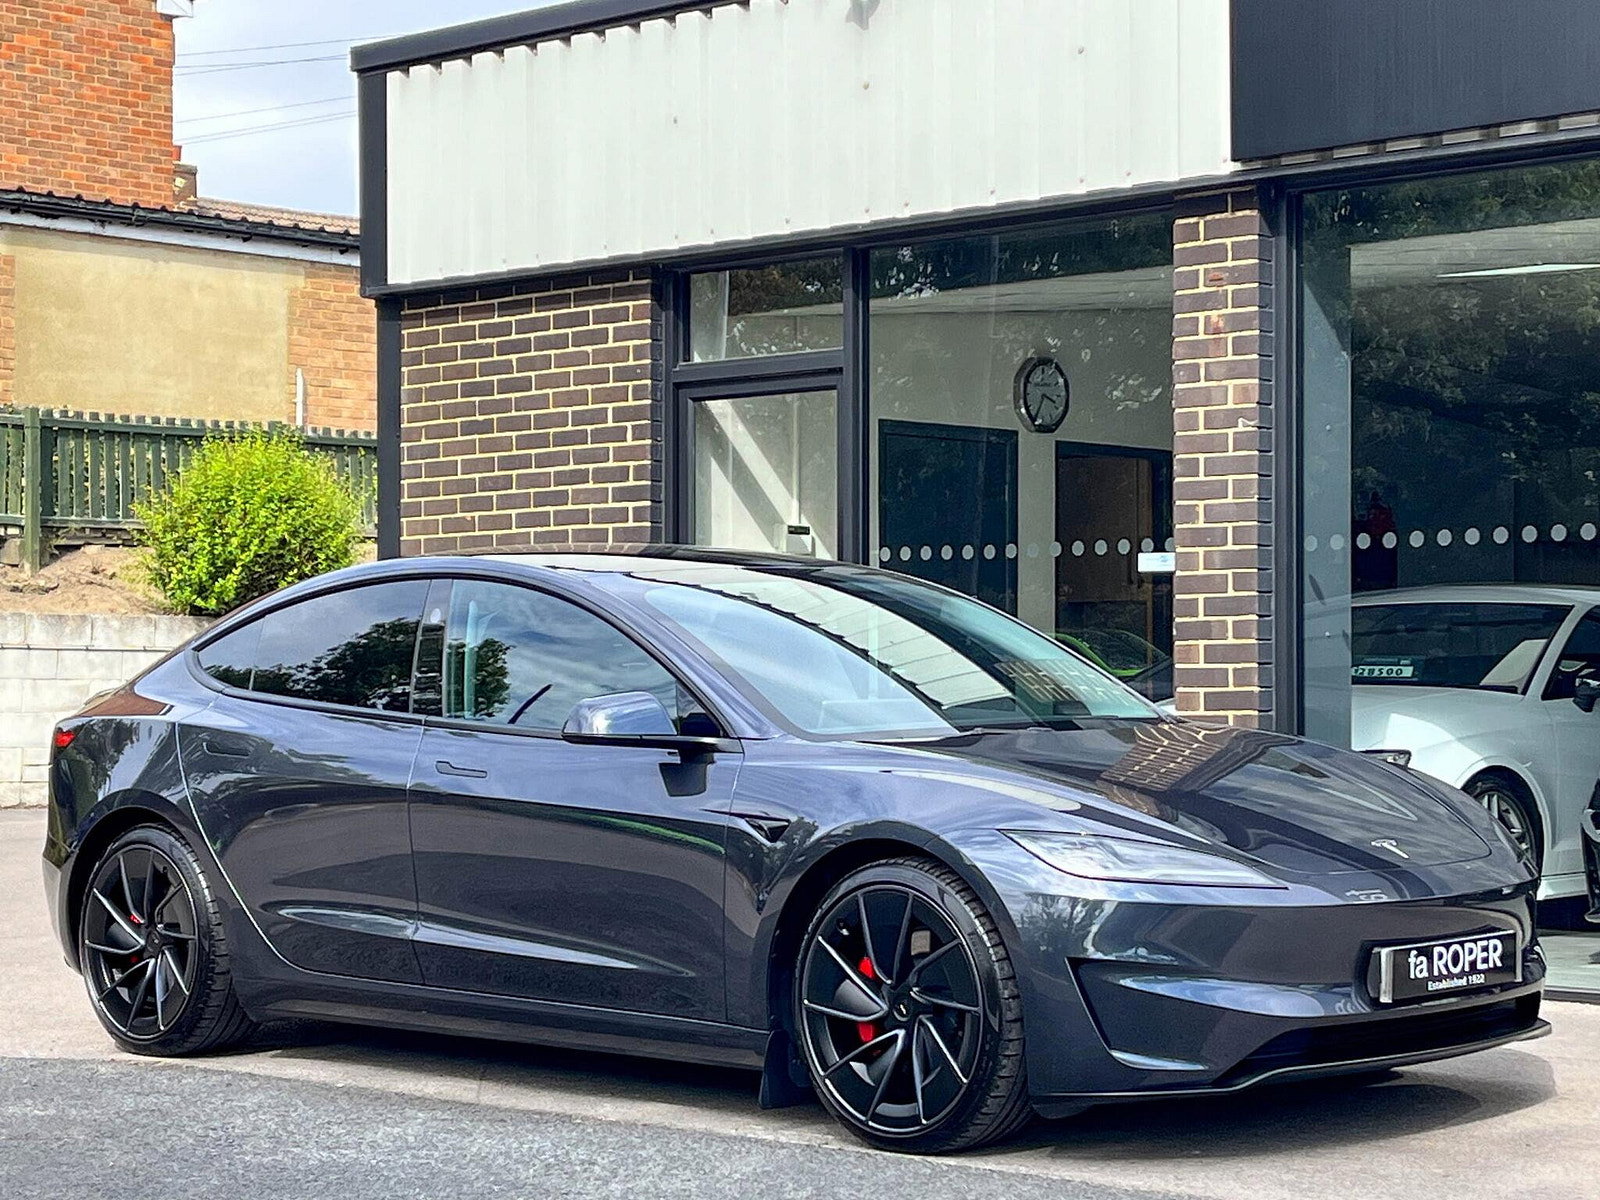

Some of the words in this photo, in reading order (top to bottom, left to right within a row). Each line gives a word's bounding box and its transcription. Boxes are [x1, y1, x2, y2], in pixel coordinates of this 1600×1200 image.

[1408, 950, 1429, 979] fa
[1433, 939, 1503, 976] ROPER
[1428, 976, 1467, 990] Established
